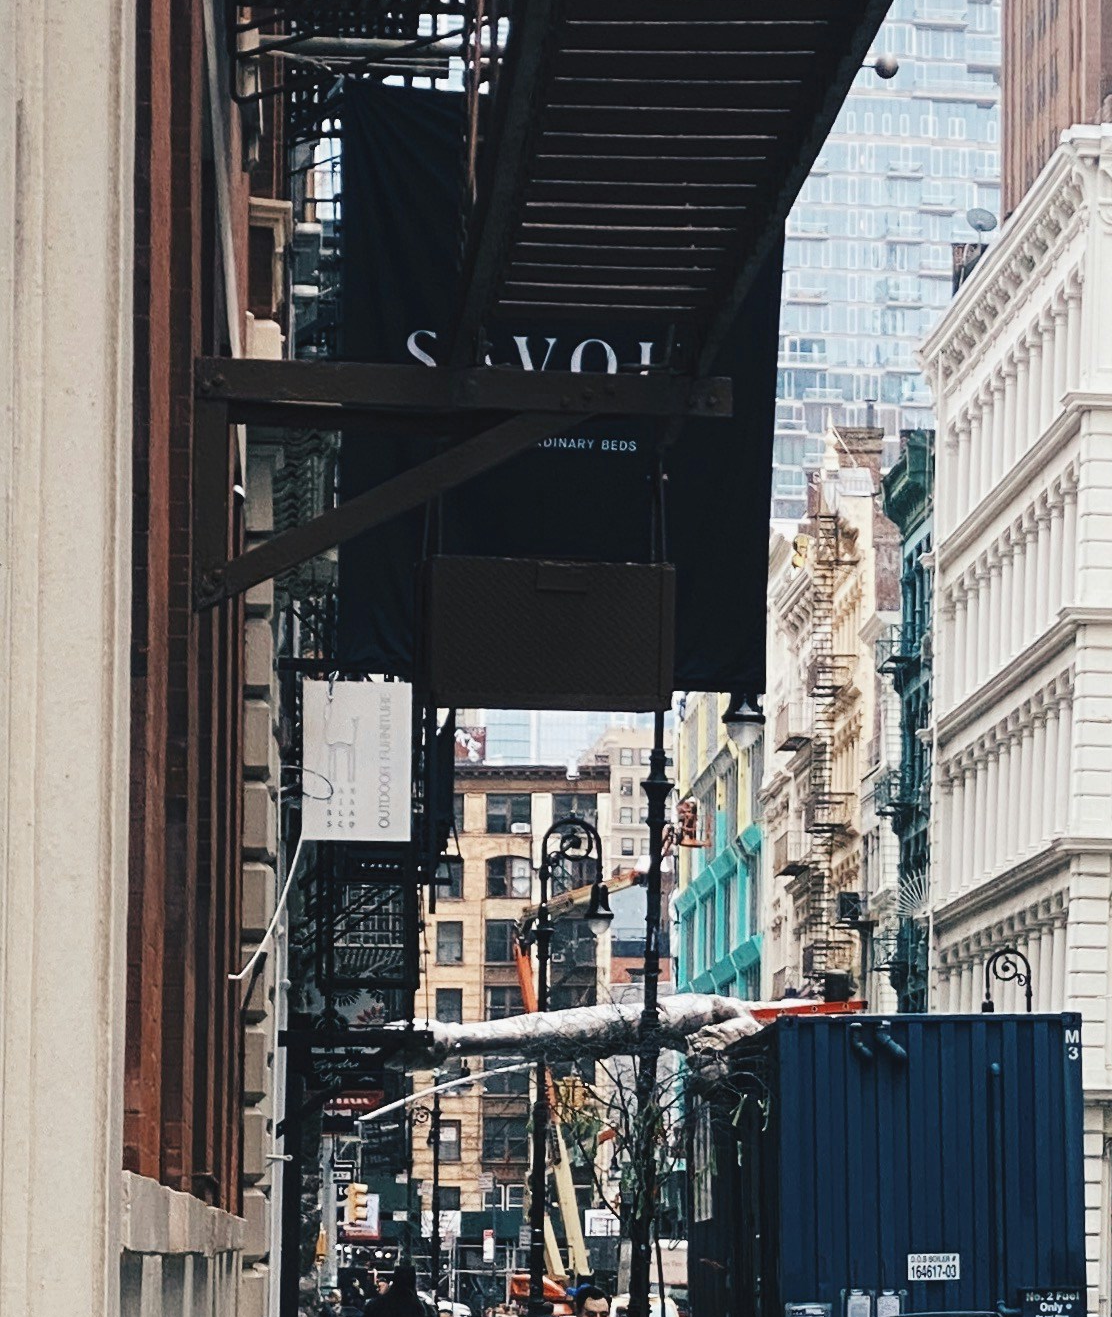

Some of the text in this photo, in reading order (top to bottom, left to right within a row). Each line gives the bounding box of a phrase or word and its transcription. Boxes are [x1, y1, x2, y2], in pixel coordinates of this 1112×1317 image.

[406, 329, 654, 376] SVOI
[601, 439, 638, 452] BEDS
[1064, 1029, 1080, 1044] M
[1068, 1046, 1079, 1060] 3
[911, 1264, 957, 1279] 164617-03
[1025, 1291, 1080, 1302] No. 2 Fuel
[1039, 1302, 1063, 1314] Only
